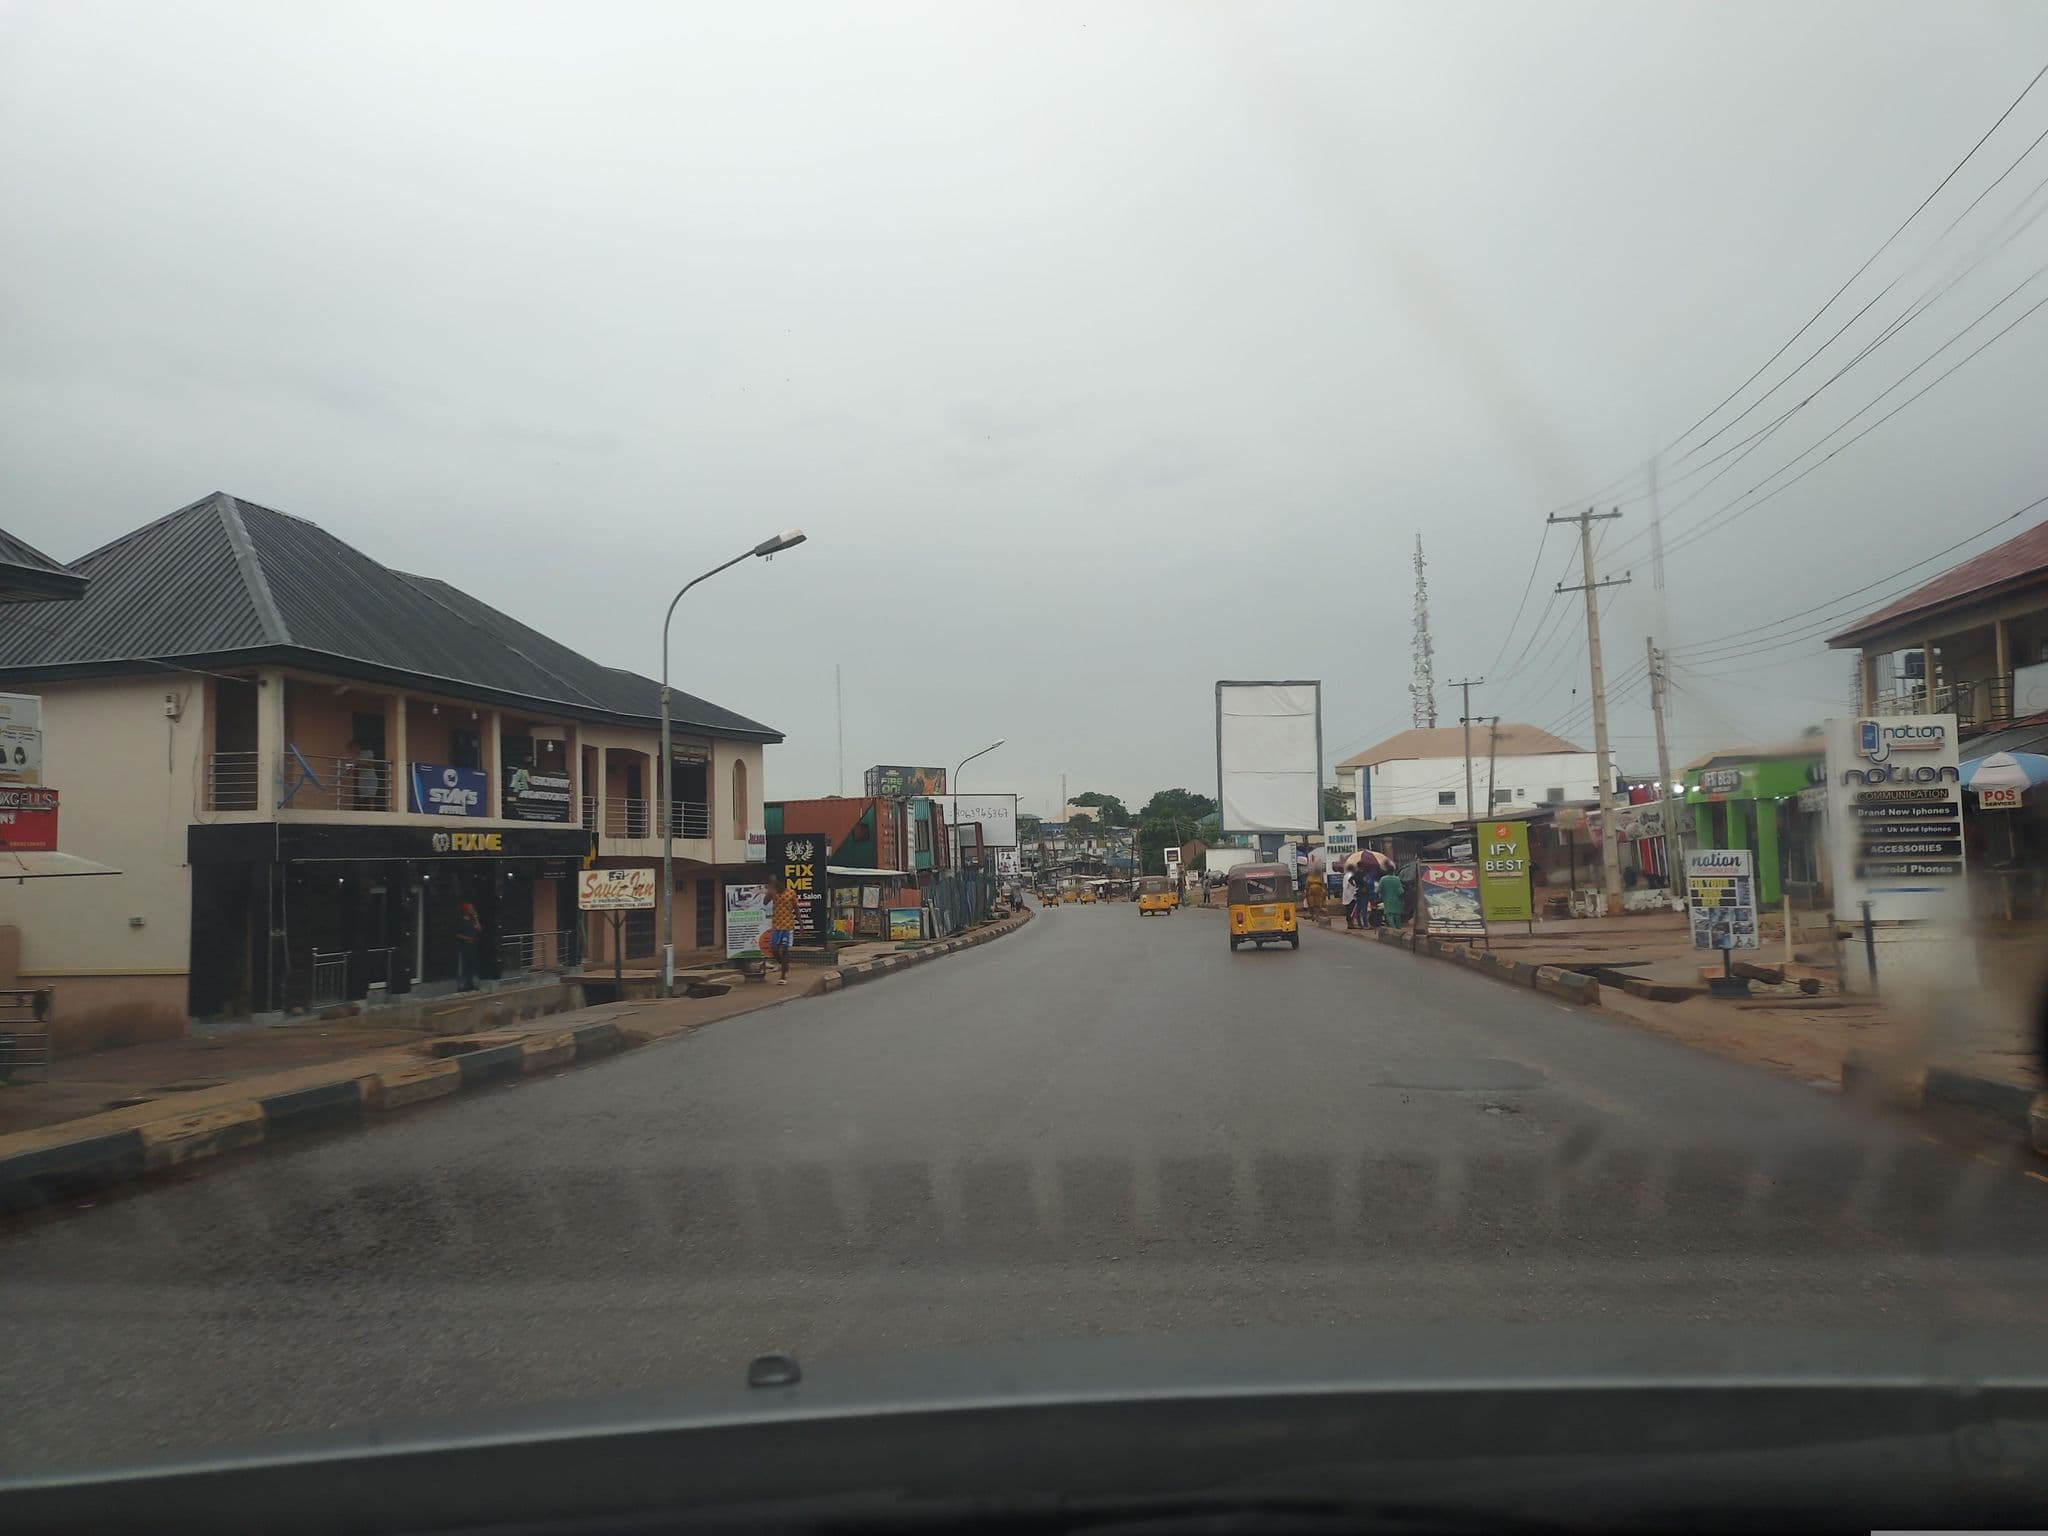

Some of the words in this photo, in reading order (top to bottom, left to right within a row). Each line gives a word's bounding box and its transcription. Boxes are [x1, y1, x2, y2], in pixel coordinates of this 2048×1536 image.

[1883, 725, 1945, 738] notion
[881, 777, 903, 786] FIRE
[1843, 765, 1960, 786] notion
[1856, 788, 1950, 801] COMMUNICATION
[1984, 790, 2015, 801] POS
[1857, 809, 1886, 817] Brand
[1888, 808, 1910, 816] New
[1912, 806, 1950, 816] Iphones
[1900, 825, 1919, 833] Used
[1921, 825, 1952, 834] Iphones
[1490, 843, 1518, 856] IFY
[1872, 844, 1943, 853] ACCESSORIES
[1485, 860, 1524, 872] BEST
[1691, 853, 1742, 867] notion
[784, 864, 815, 877] FIX
[1429, 869, 1474, 881] POS
[1910, 865, 1953, 874] Phones
[786, 878, 813, 890] ME
